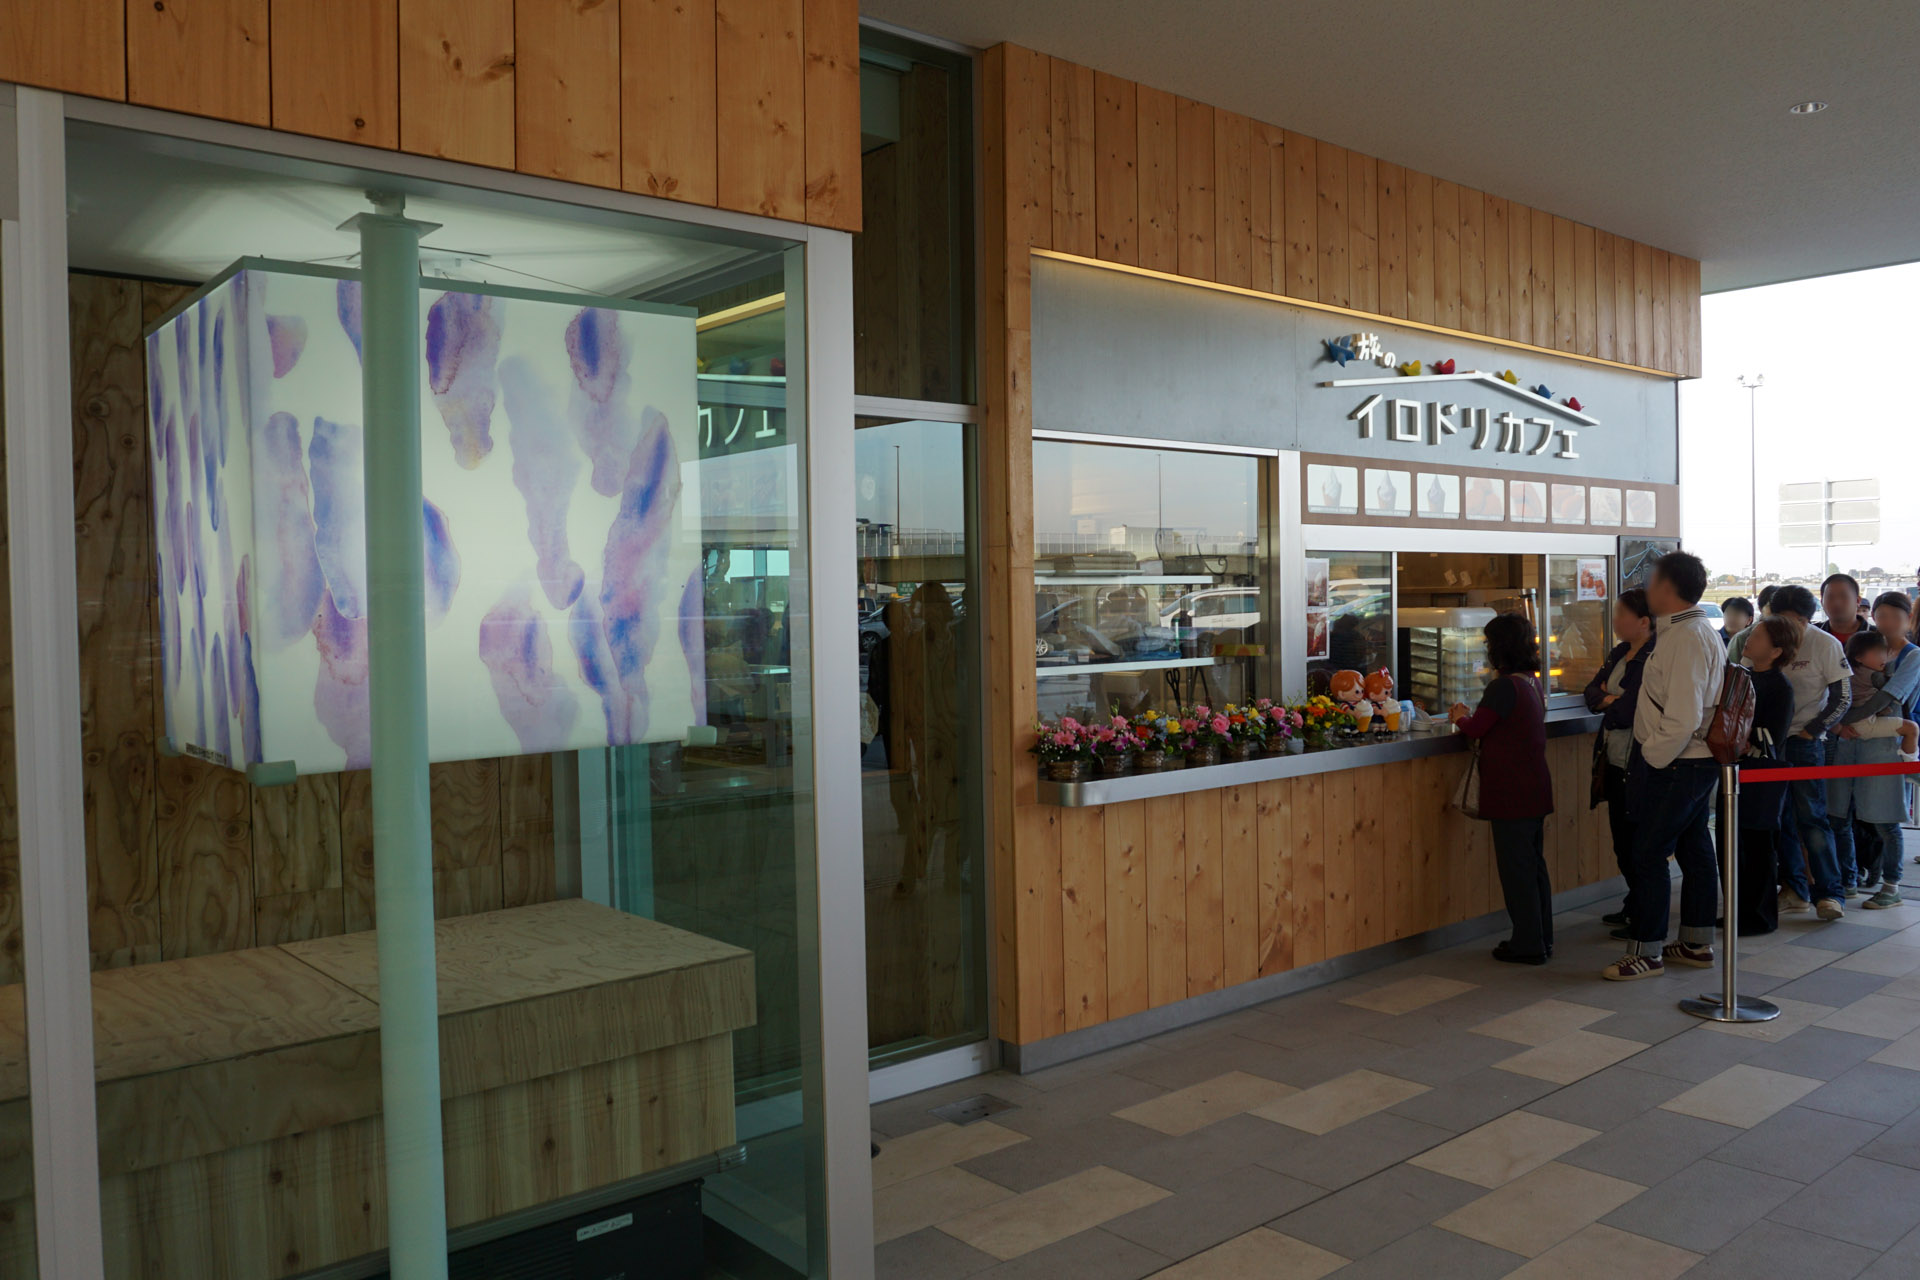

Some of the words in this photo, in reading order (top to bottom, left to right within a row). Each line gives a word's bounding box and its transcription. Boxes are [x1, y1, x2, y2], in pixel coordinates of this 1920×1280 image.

[1356, 332, 1397, 369] 旅の
[1352, 393, 1581, 459] イロドリカフェ
